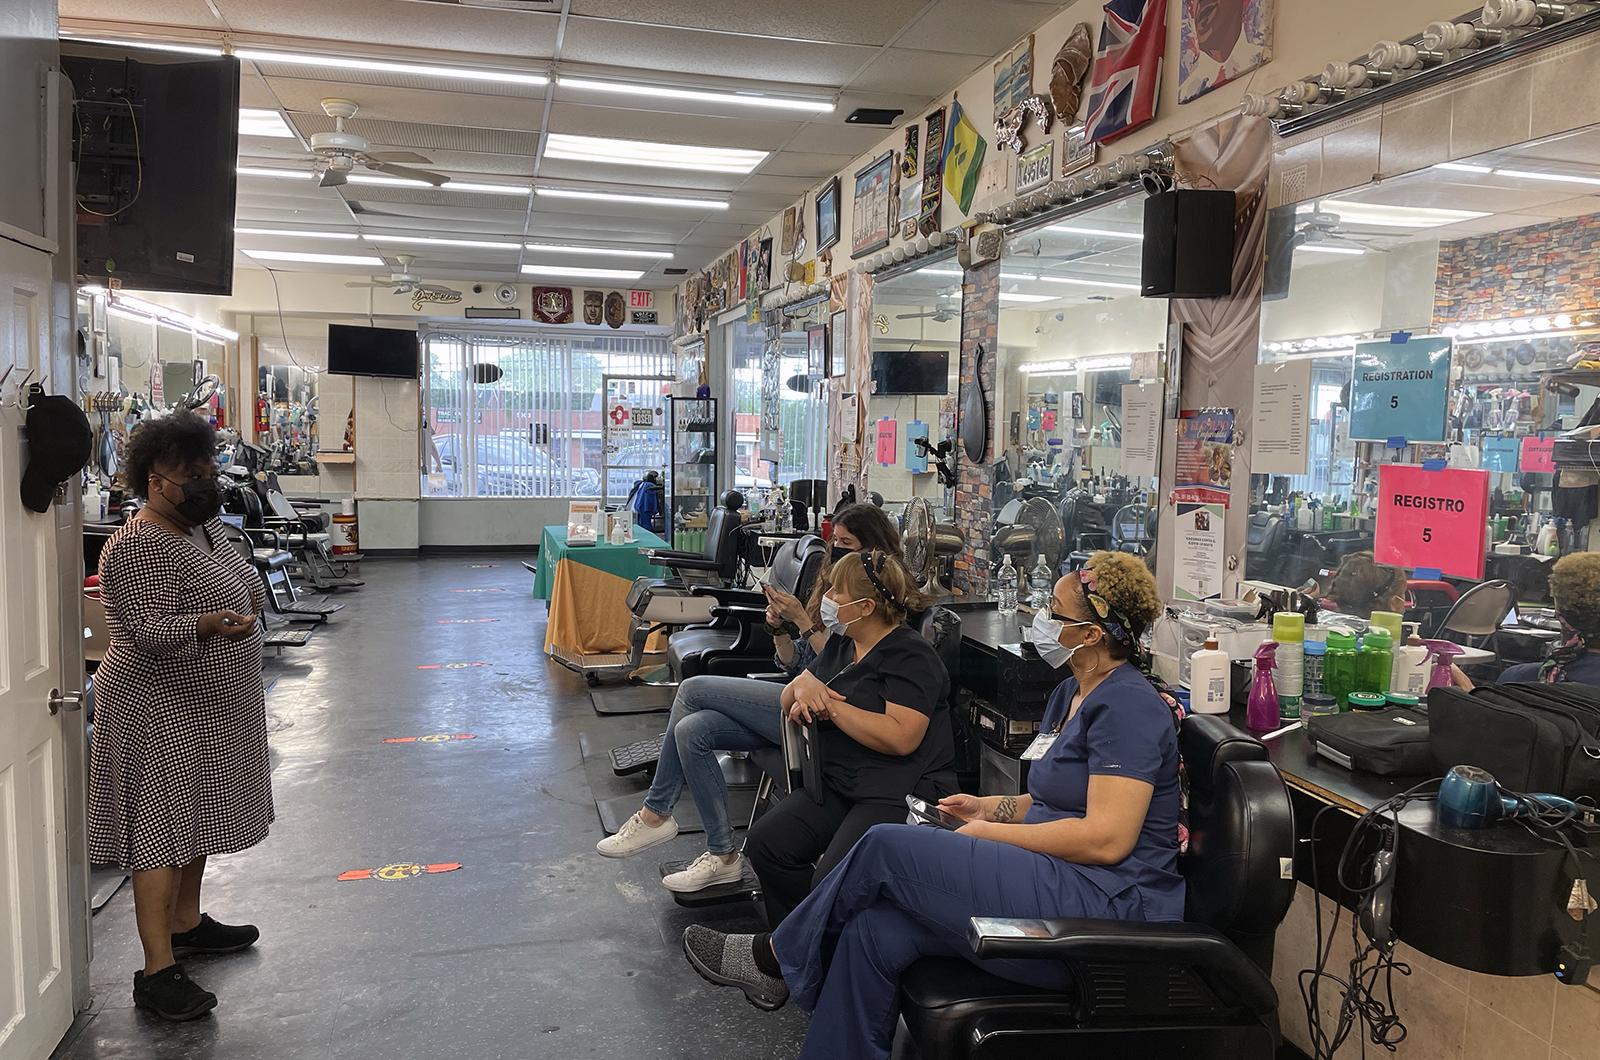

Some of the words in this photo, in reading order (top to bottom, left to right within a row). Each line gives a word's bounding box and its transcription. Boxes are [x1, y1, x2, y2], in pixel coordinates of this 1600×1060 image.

[631, 291, 650, 307] EXIT
[1362, 370, 1434, 382] REGISTRATION
[1390, 395, 1399, 409] 5
[1393, 494, 1465, 513] REGISTRO
[1422, 527, 1432, 543] 5
